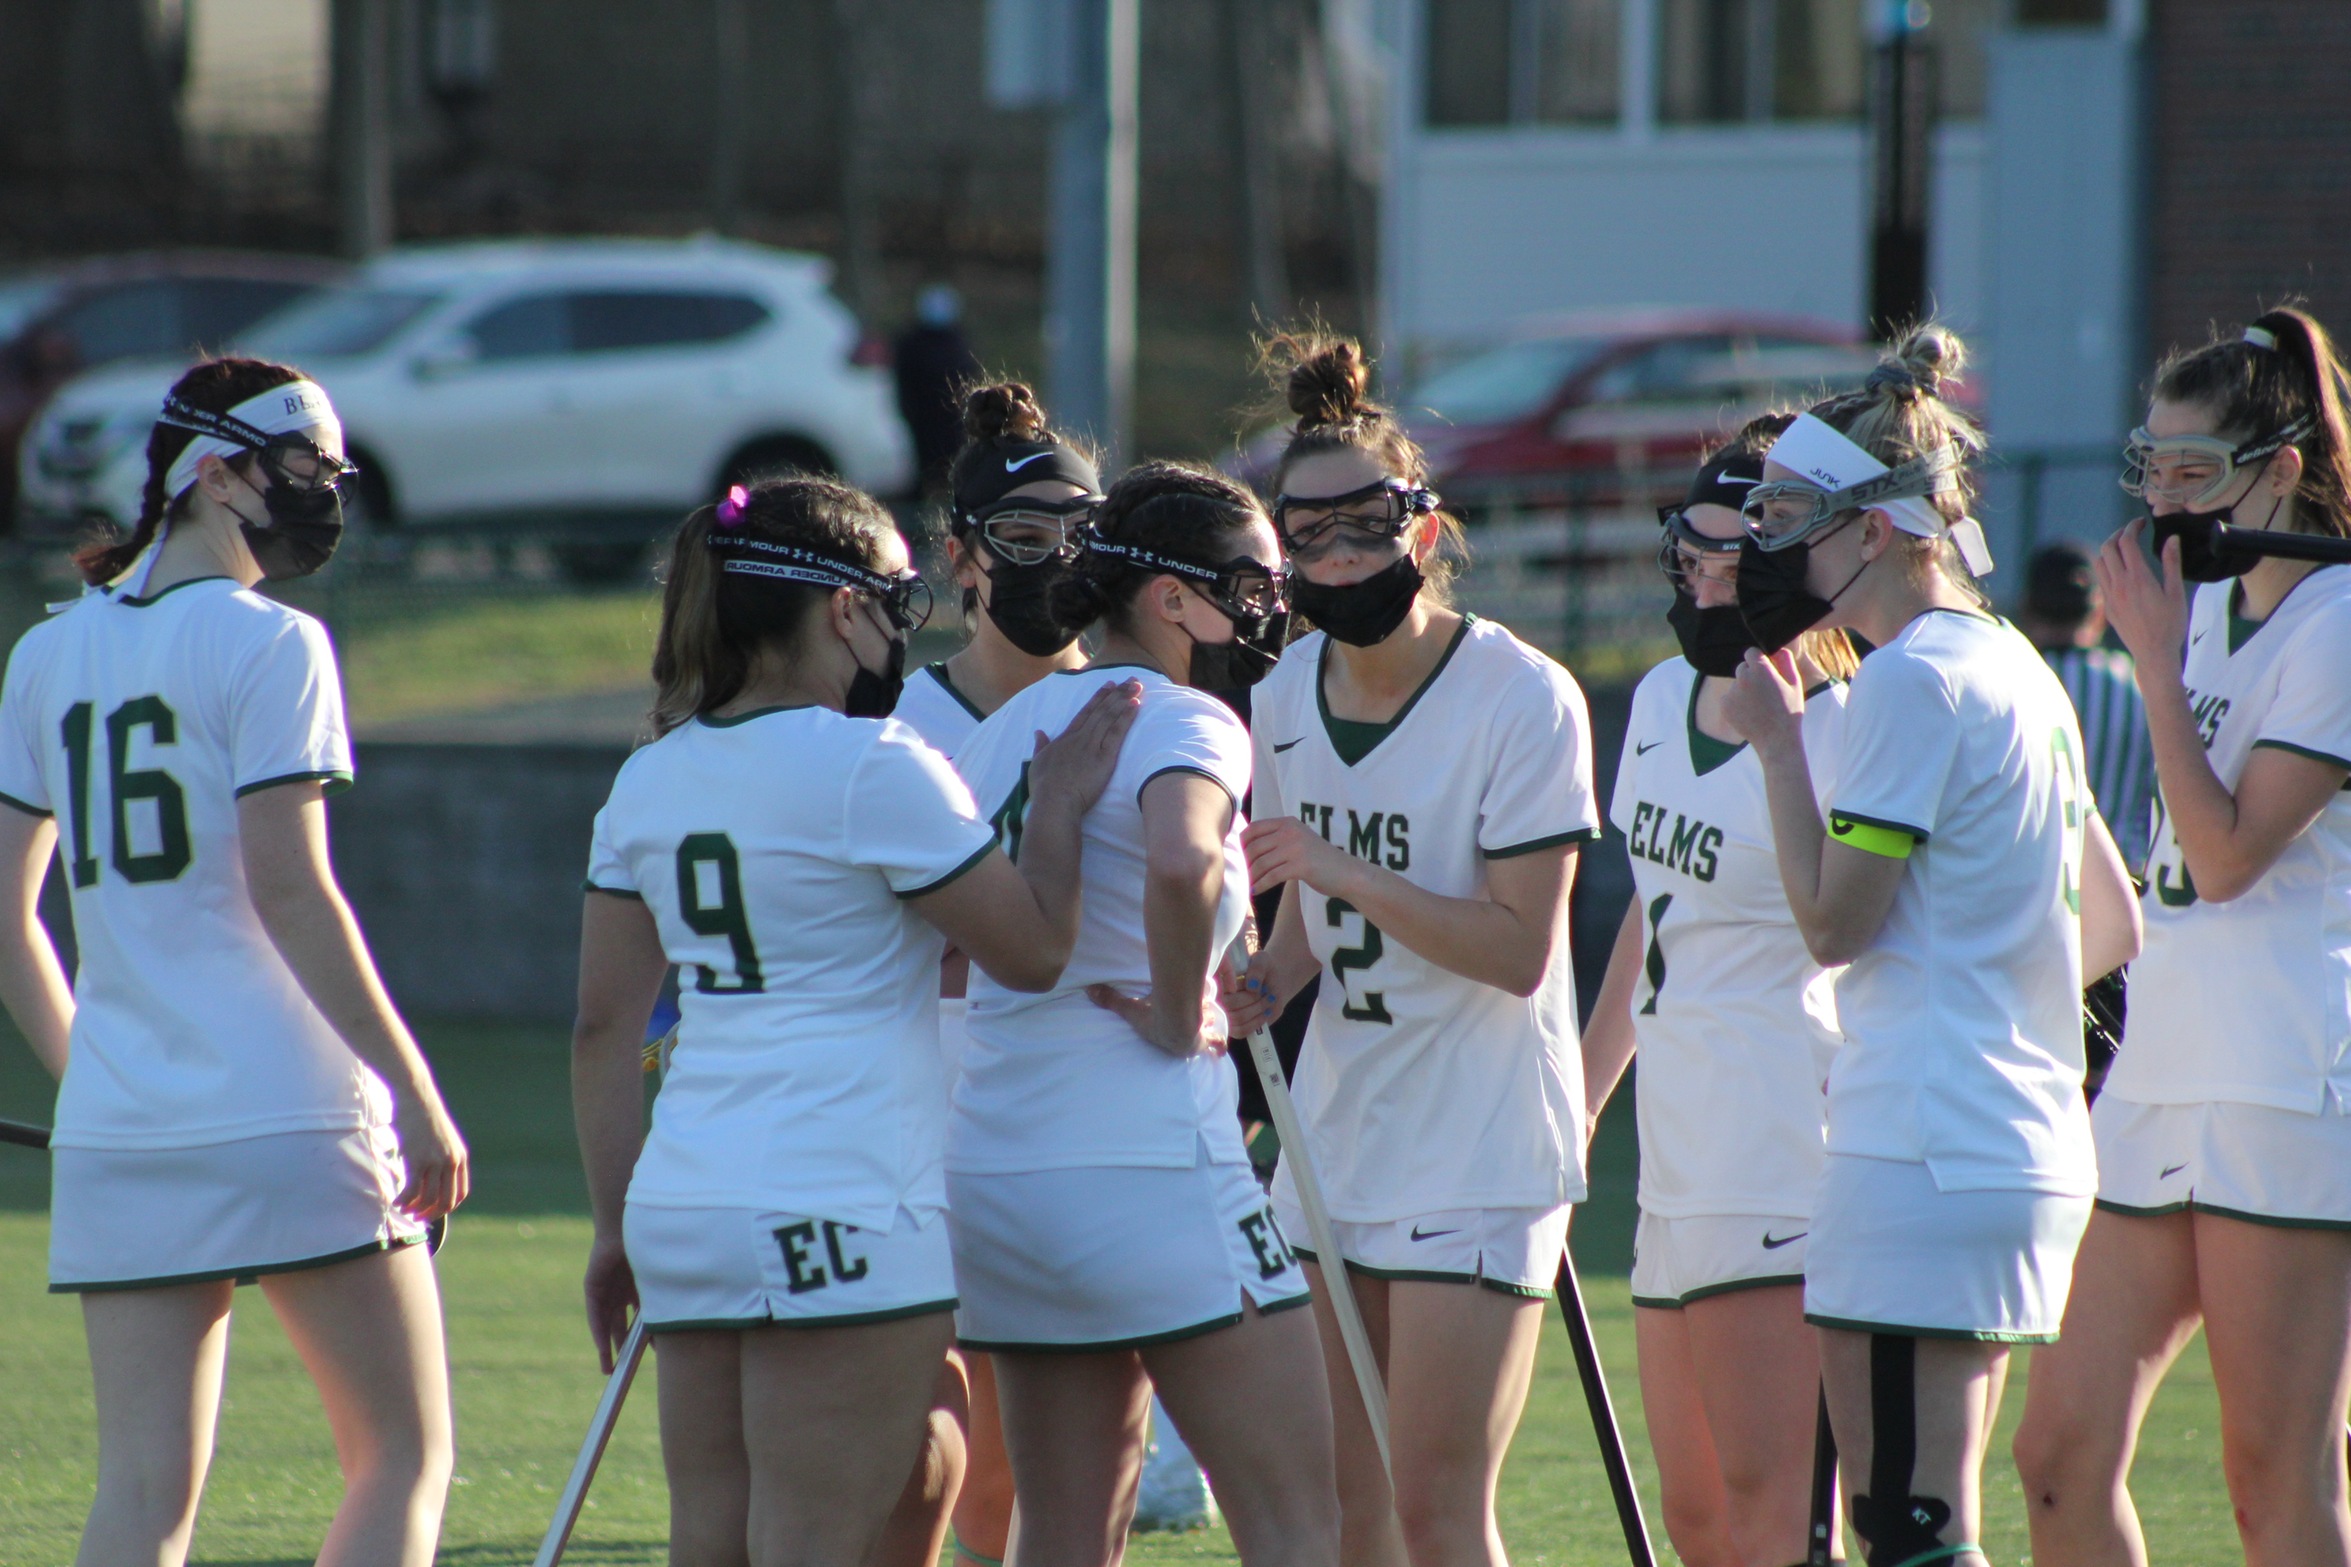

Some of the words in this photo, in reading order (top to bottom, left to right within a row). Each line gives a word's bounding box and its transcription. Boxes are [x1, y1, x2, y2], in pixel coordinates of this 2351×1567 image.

[1809, 468, 1840, 488] JUNK
[1851, 474, 1898, 501] STX
[817, 556, 863, 579] UNDER
[1158, 556, 1218, 580] UNDER
[61, 693, 194, 891] 16
[1629, 801, 1723, 883] ELMS
[675, 830, 767, 994] 9
[1325, 896, 1393, 1025] 2
[1639, 893, 1674, 1016] 1
[772, 1219, 868, 1295] EC
[1911, 1507, 1932, 1526] KT
